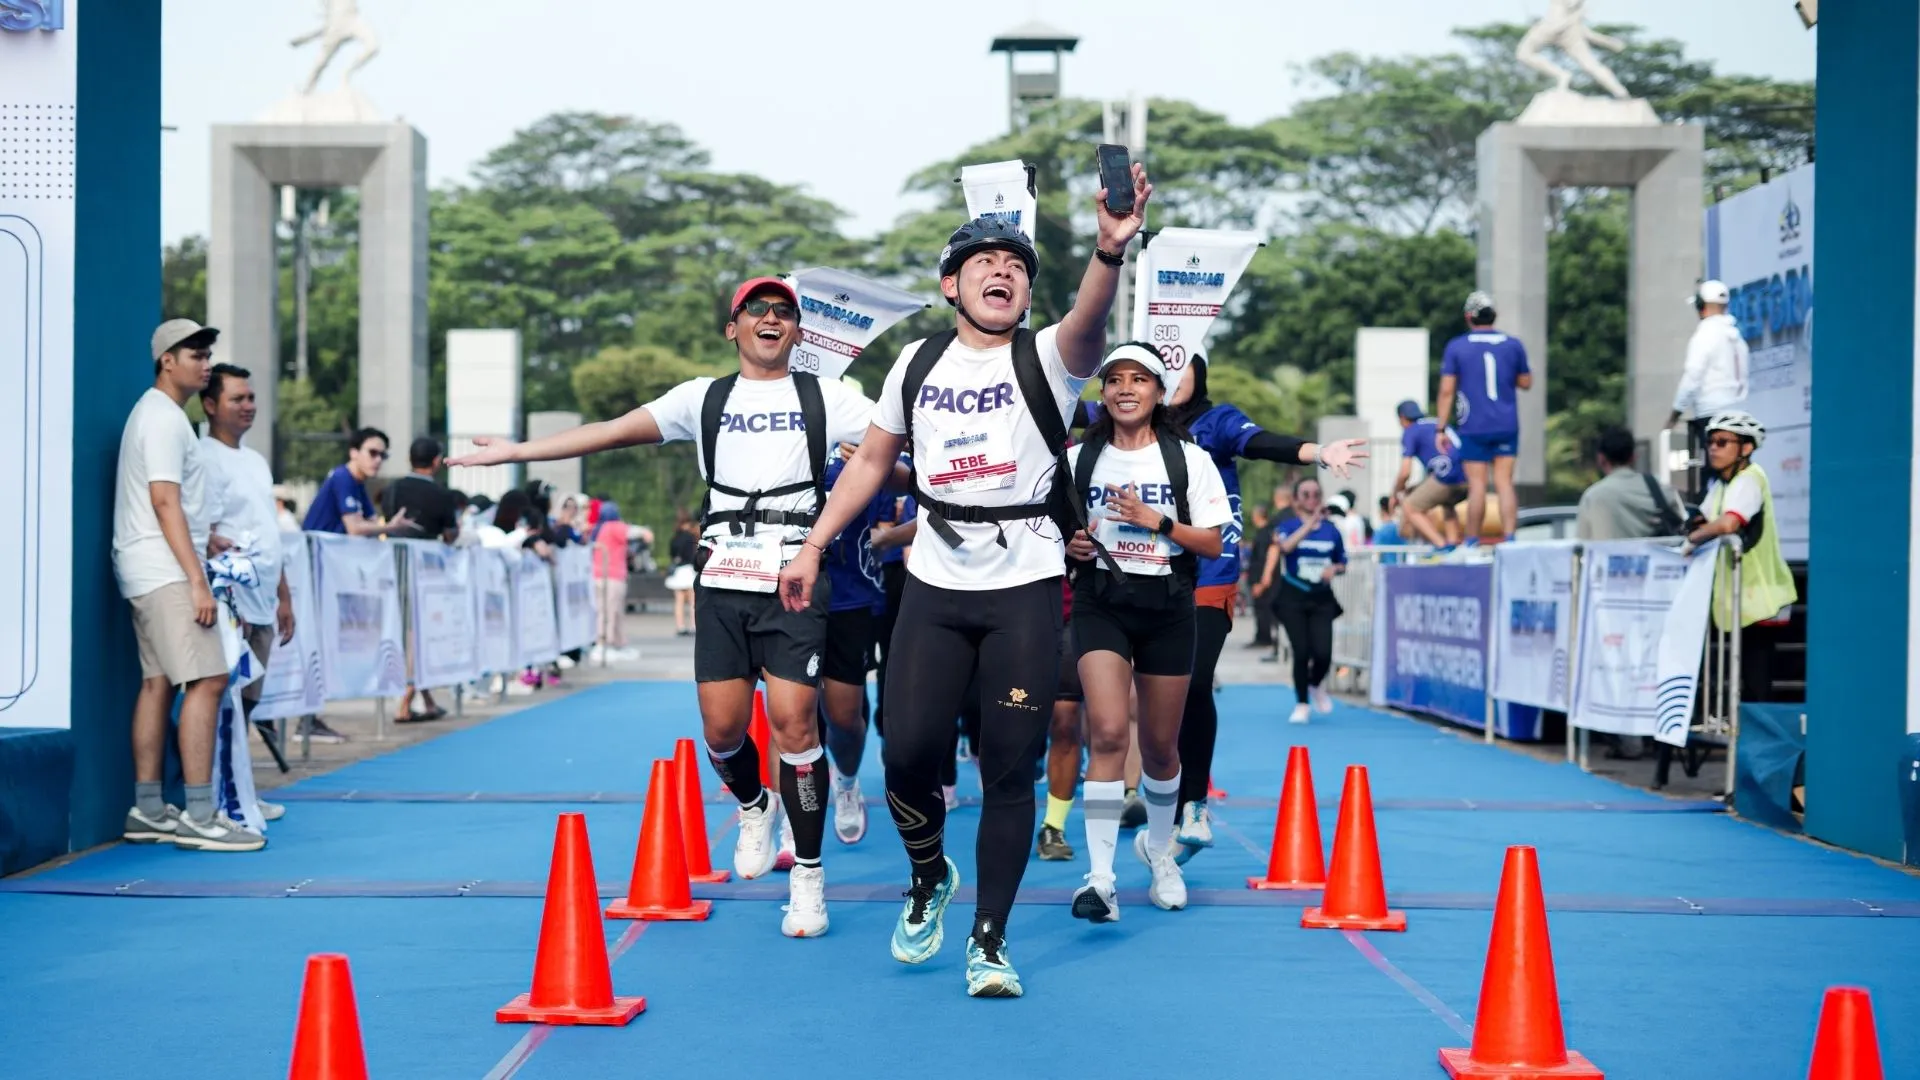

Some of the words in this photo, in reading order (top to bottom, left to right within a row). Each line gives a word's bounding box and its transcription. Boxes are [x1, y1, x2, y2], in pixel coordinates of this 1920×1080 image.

[1158, 271, 1225, 286] REFORMASI
[801, 295, 874, 330] REFORMASI
[1172, 304, 1213, 315] CATEGORY
[1154, 324, 1180, 341] SUB
[812, 334, 855, 356] CATEGORY
[796, 349, 819, 371] SUB
[919, 382, 1015, 415] PACER
[720, 411, 806, 433] PACER
[949, 454, 989, 471] TEBE
[1118, 541, 1155, 554] NOON
[719, 557, 762, 570] AKBAR
